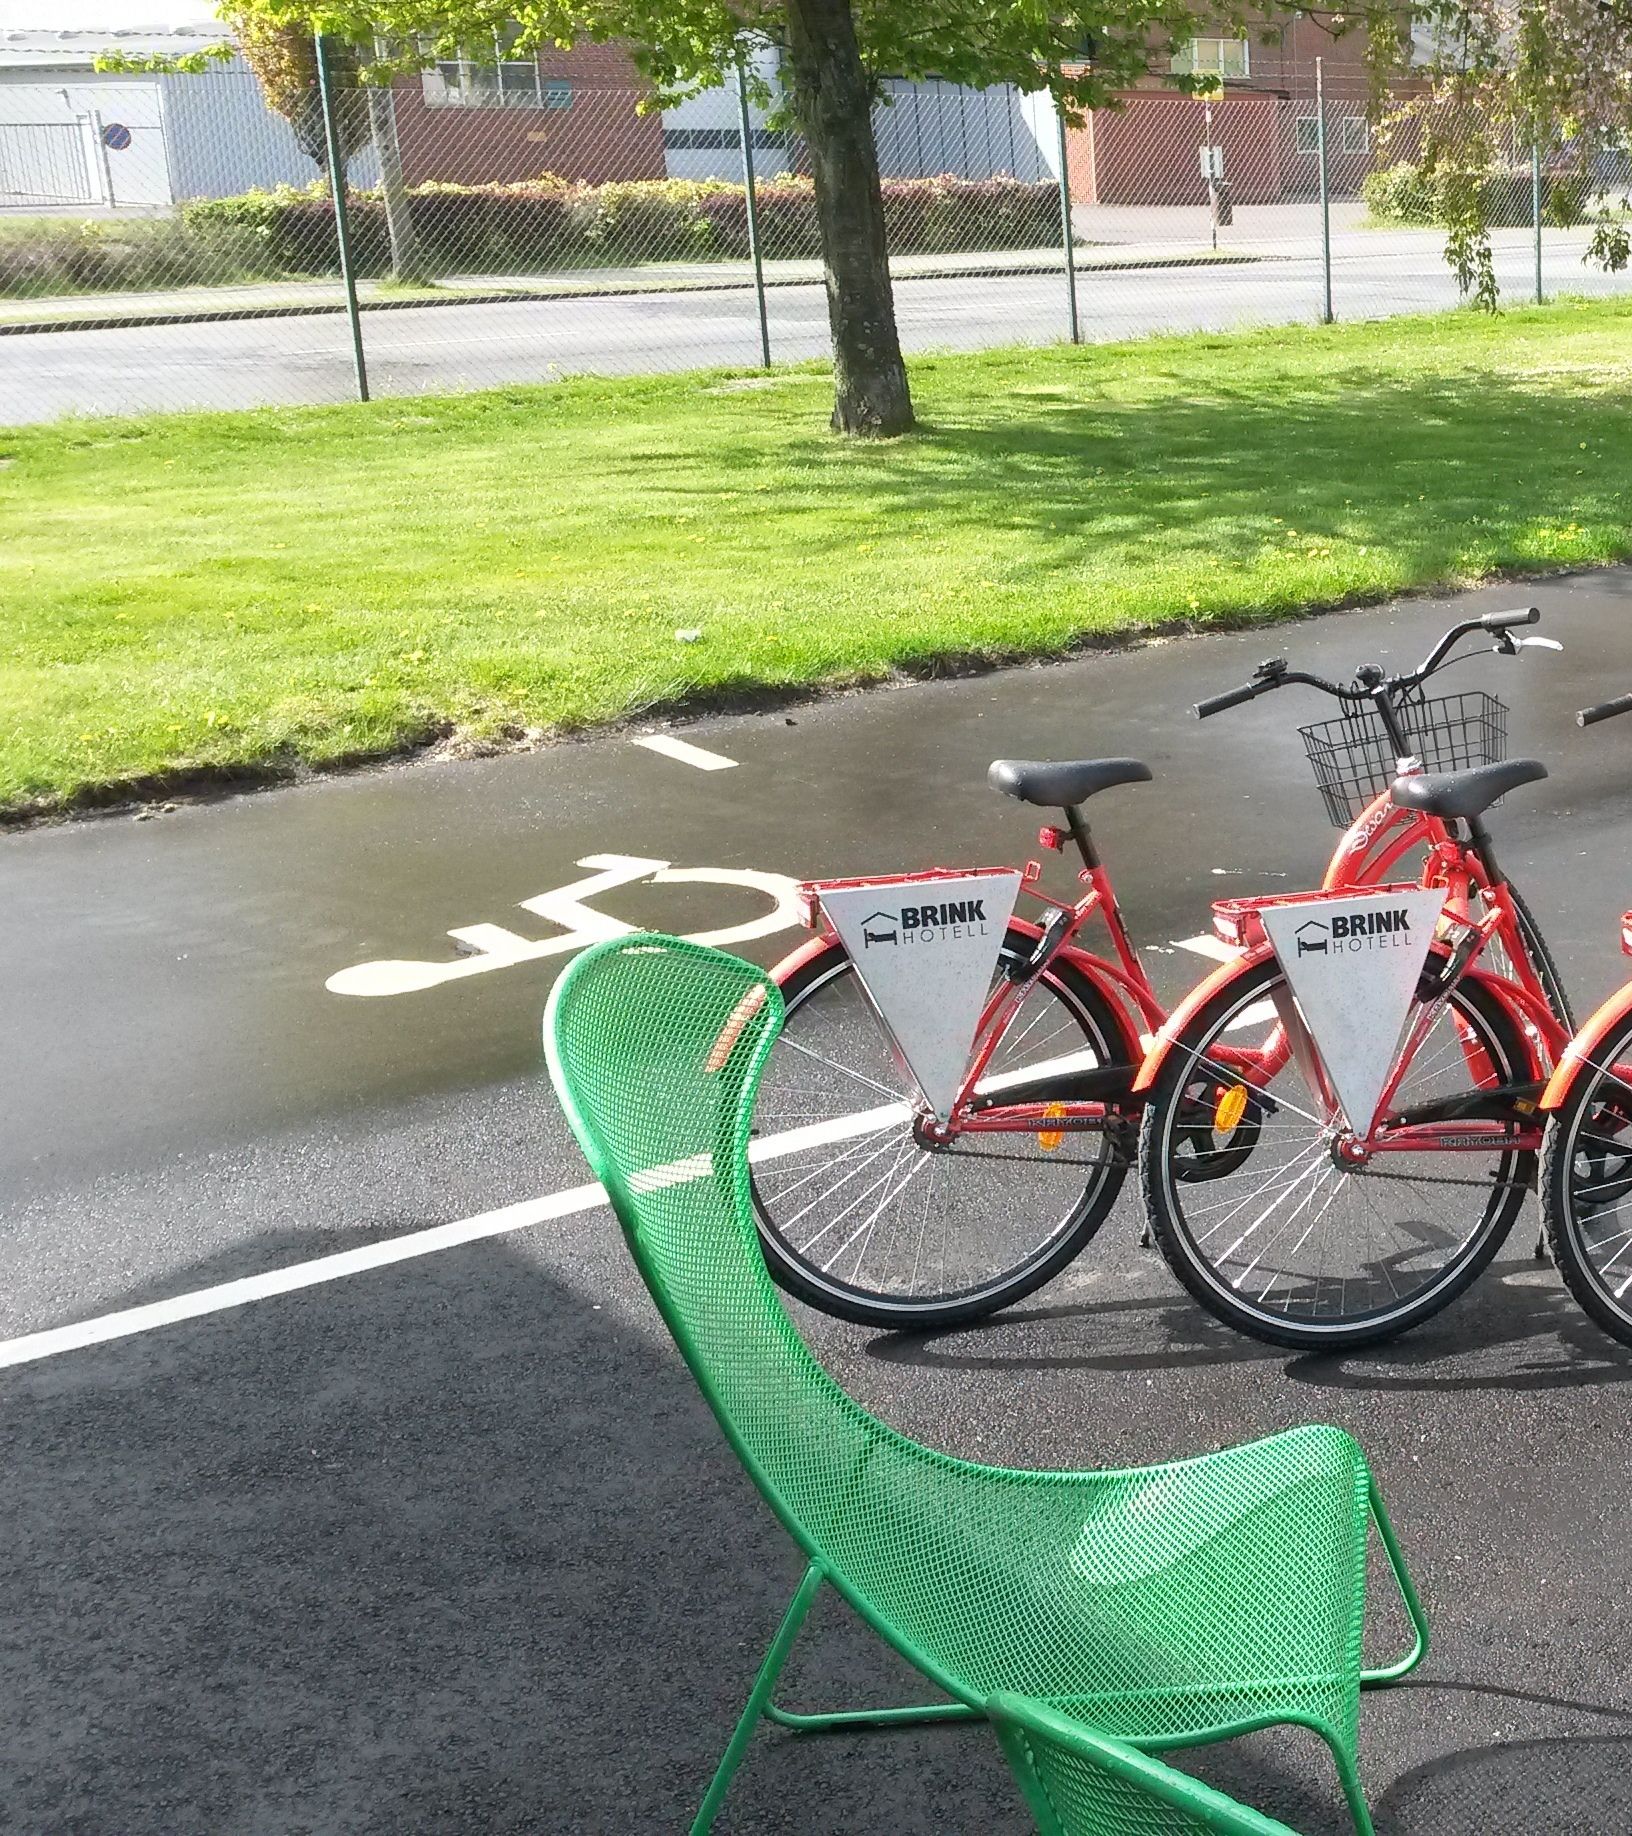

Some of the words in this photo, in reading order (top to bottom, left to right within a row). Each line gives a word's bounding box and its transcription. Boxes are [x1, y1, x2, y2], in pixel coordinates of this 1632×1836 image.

[901, 899, 987, 929] BRINK
[1331, 909, 1410, 938] BRINK
[903, 923, 988, 944] HOTELL
[1333, 933, 1412, 953] HOTELL
